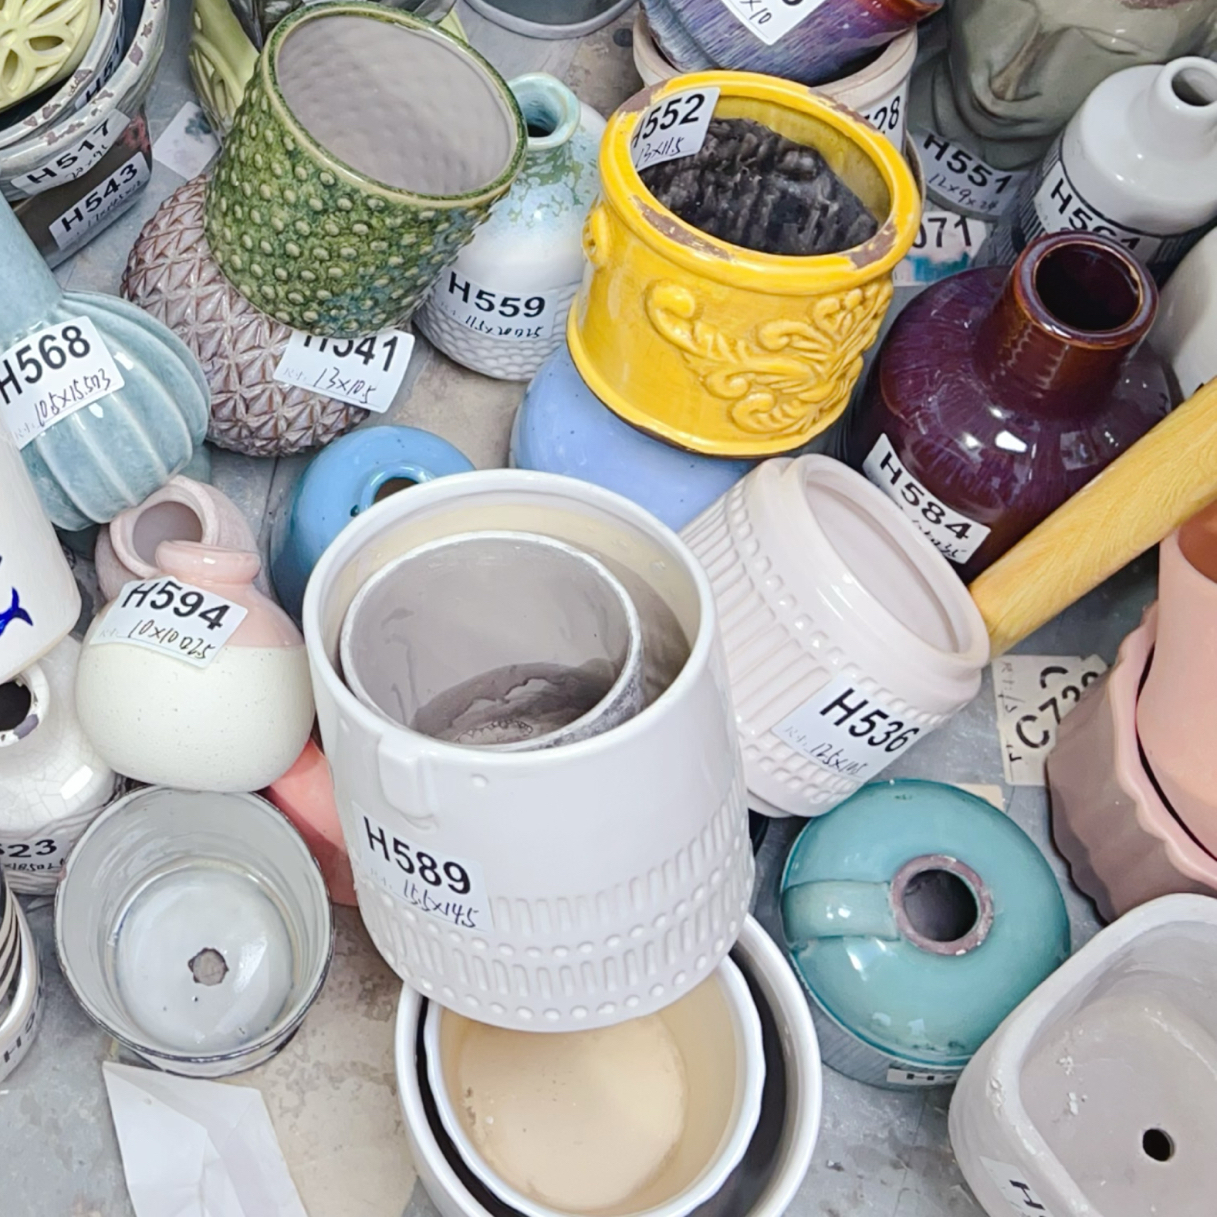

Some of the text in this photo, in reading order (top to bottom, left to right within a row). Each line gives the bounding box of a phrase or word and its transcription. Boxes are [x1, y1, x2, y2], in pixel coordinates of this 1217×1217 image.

[866, 96, 900, 135] 28
[27, 123, 110, 184] H517
[924, 134, 1013, 193] H551
[62, 165, 137, 232] H543
[448, 273, 546, 318] H559
[880, 453, 969, 539] H584
[122, 583, 231, 631] H594
[819, 687, 920, 752] H536
[363, 815, 471, 895] H589
